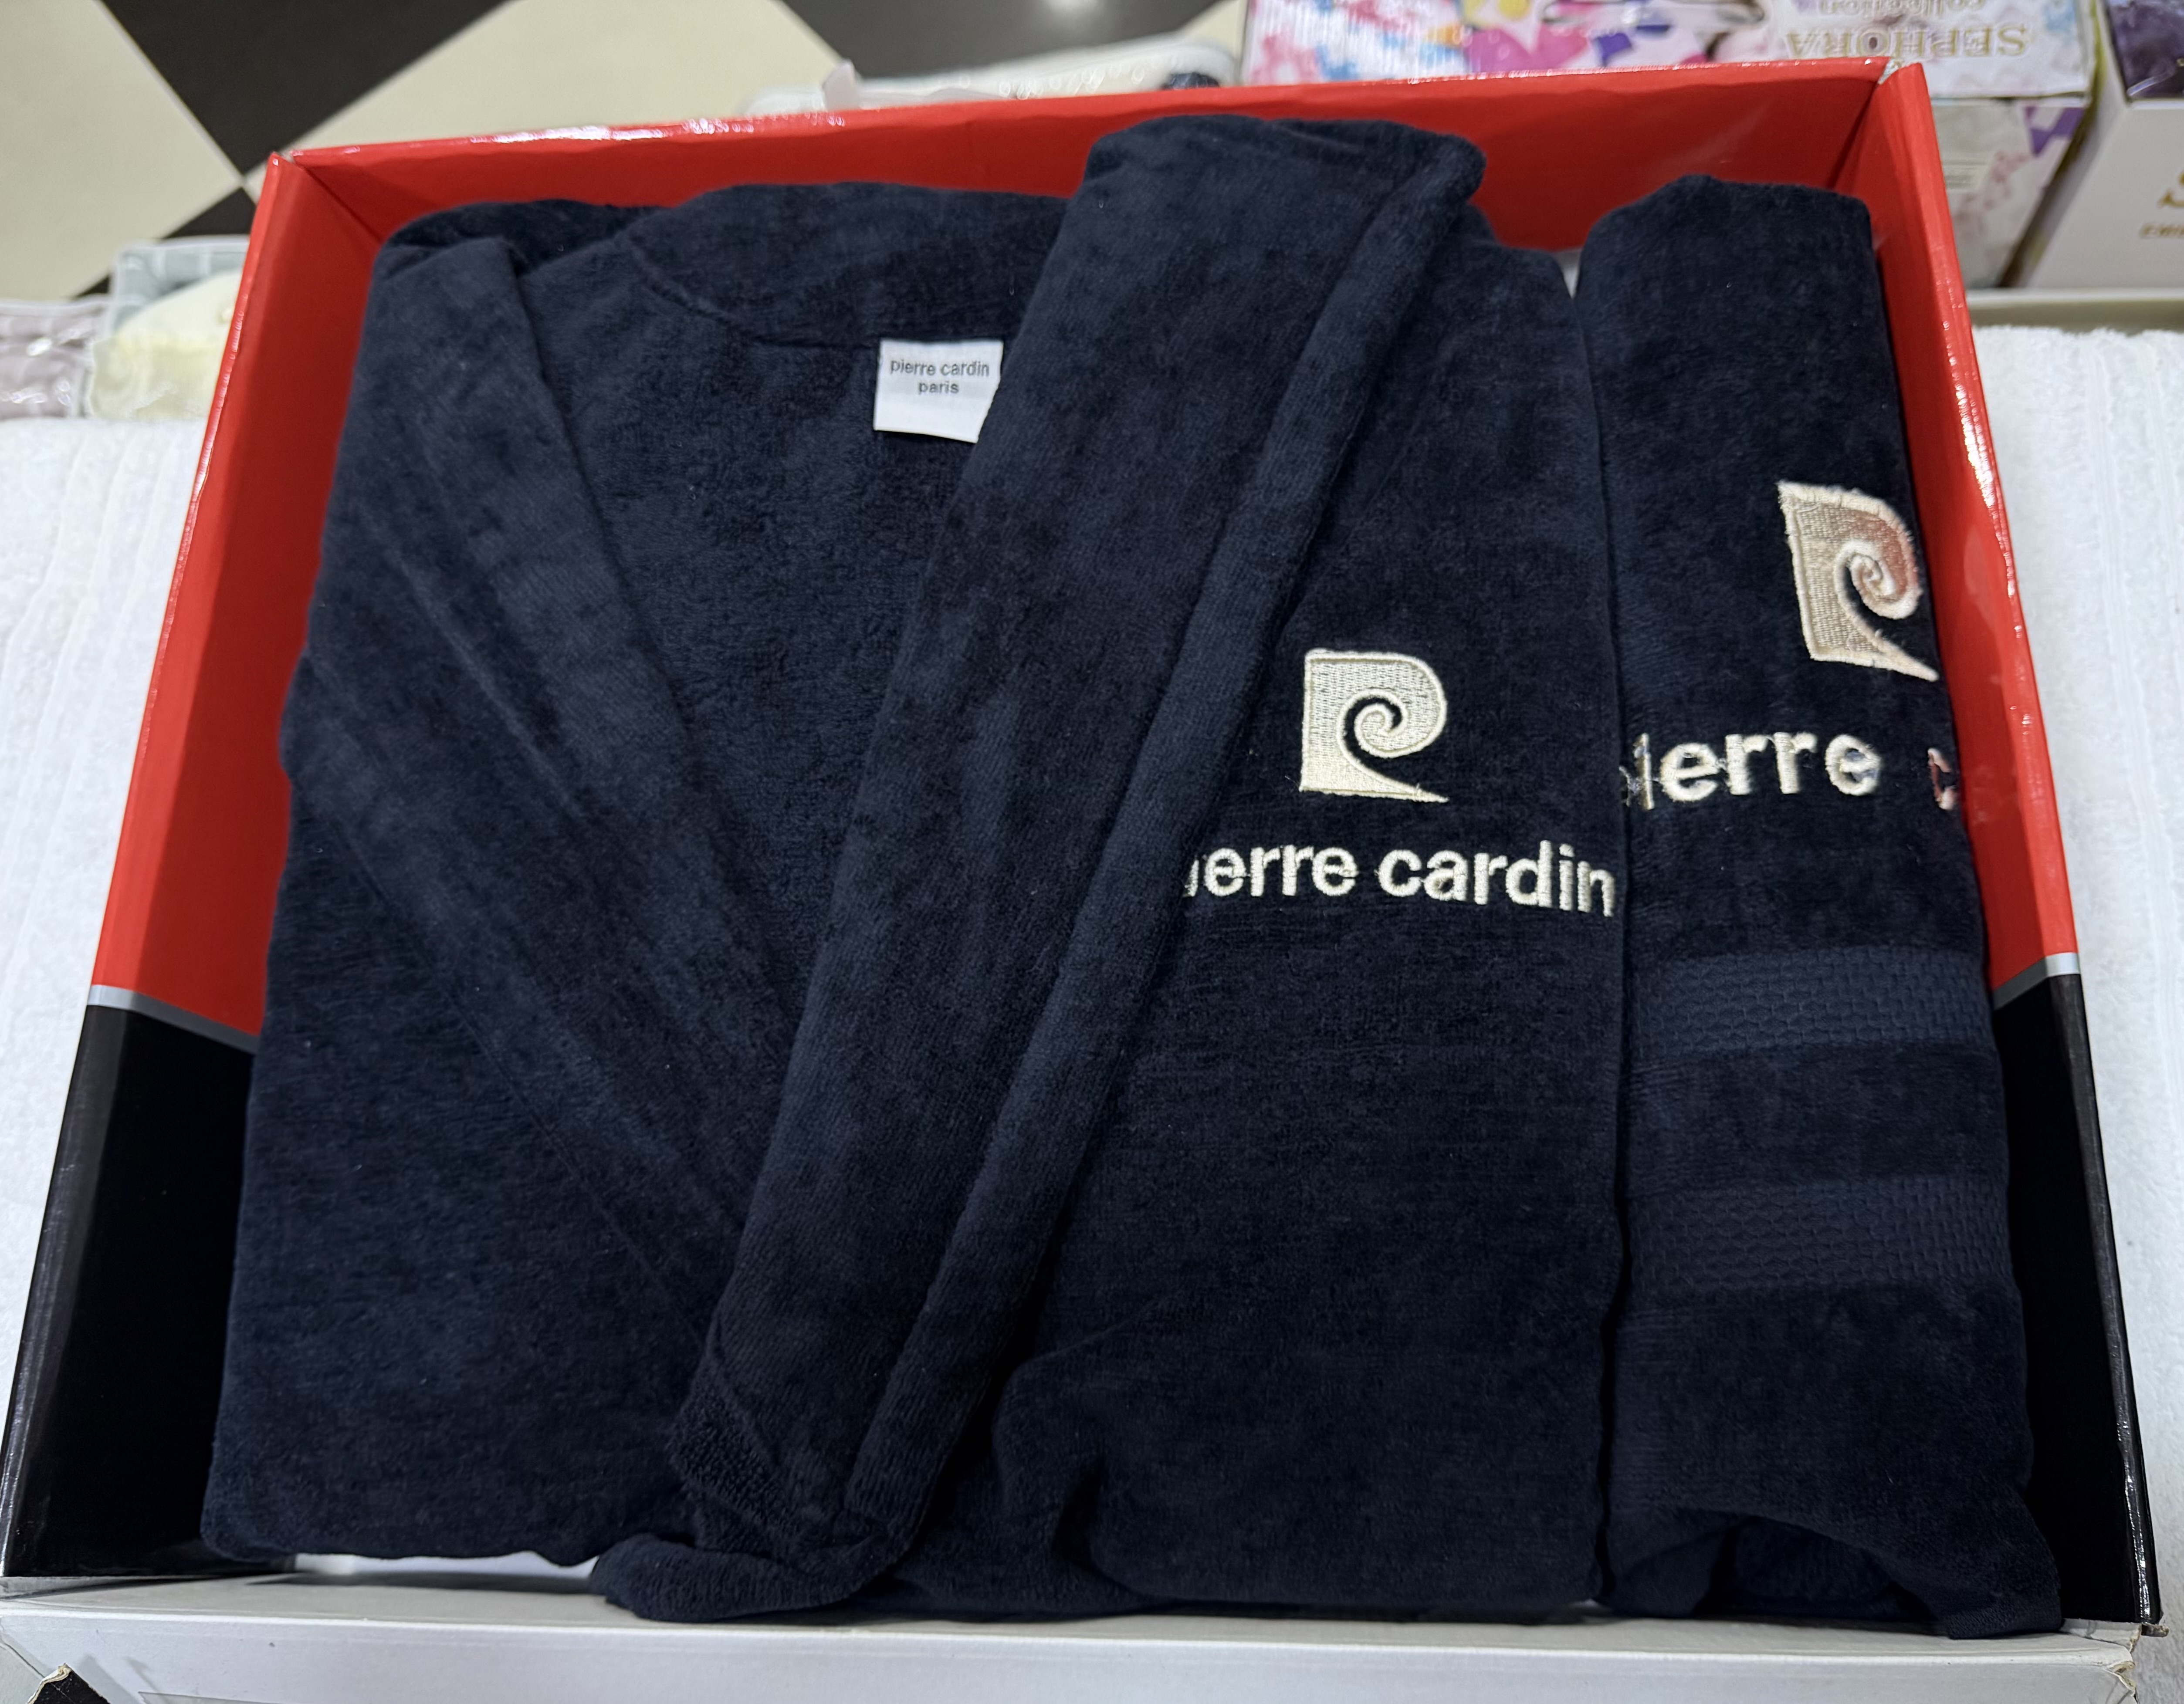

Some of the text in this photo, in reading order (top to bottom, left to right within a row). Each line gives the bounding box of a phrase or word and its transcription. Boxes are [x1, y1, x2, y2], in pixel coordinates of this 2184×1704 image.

[1786, 23, 2027, 57] SEPHORA
[890, 359, 989, 376] pierre cardin
[918, 382, 959, 394] paris
[1377, 840, 1615, 917] cardin
